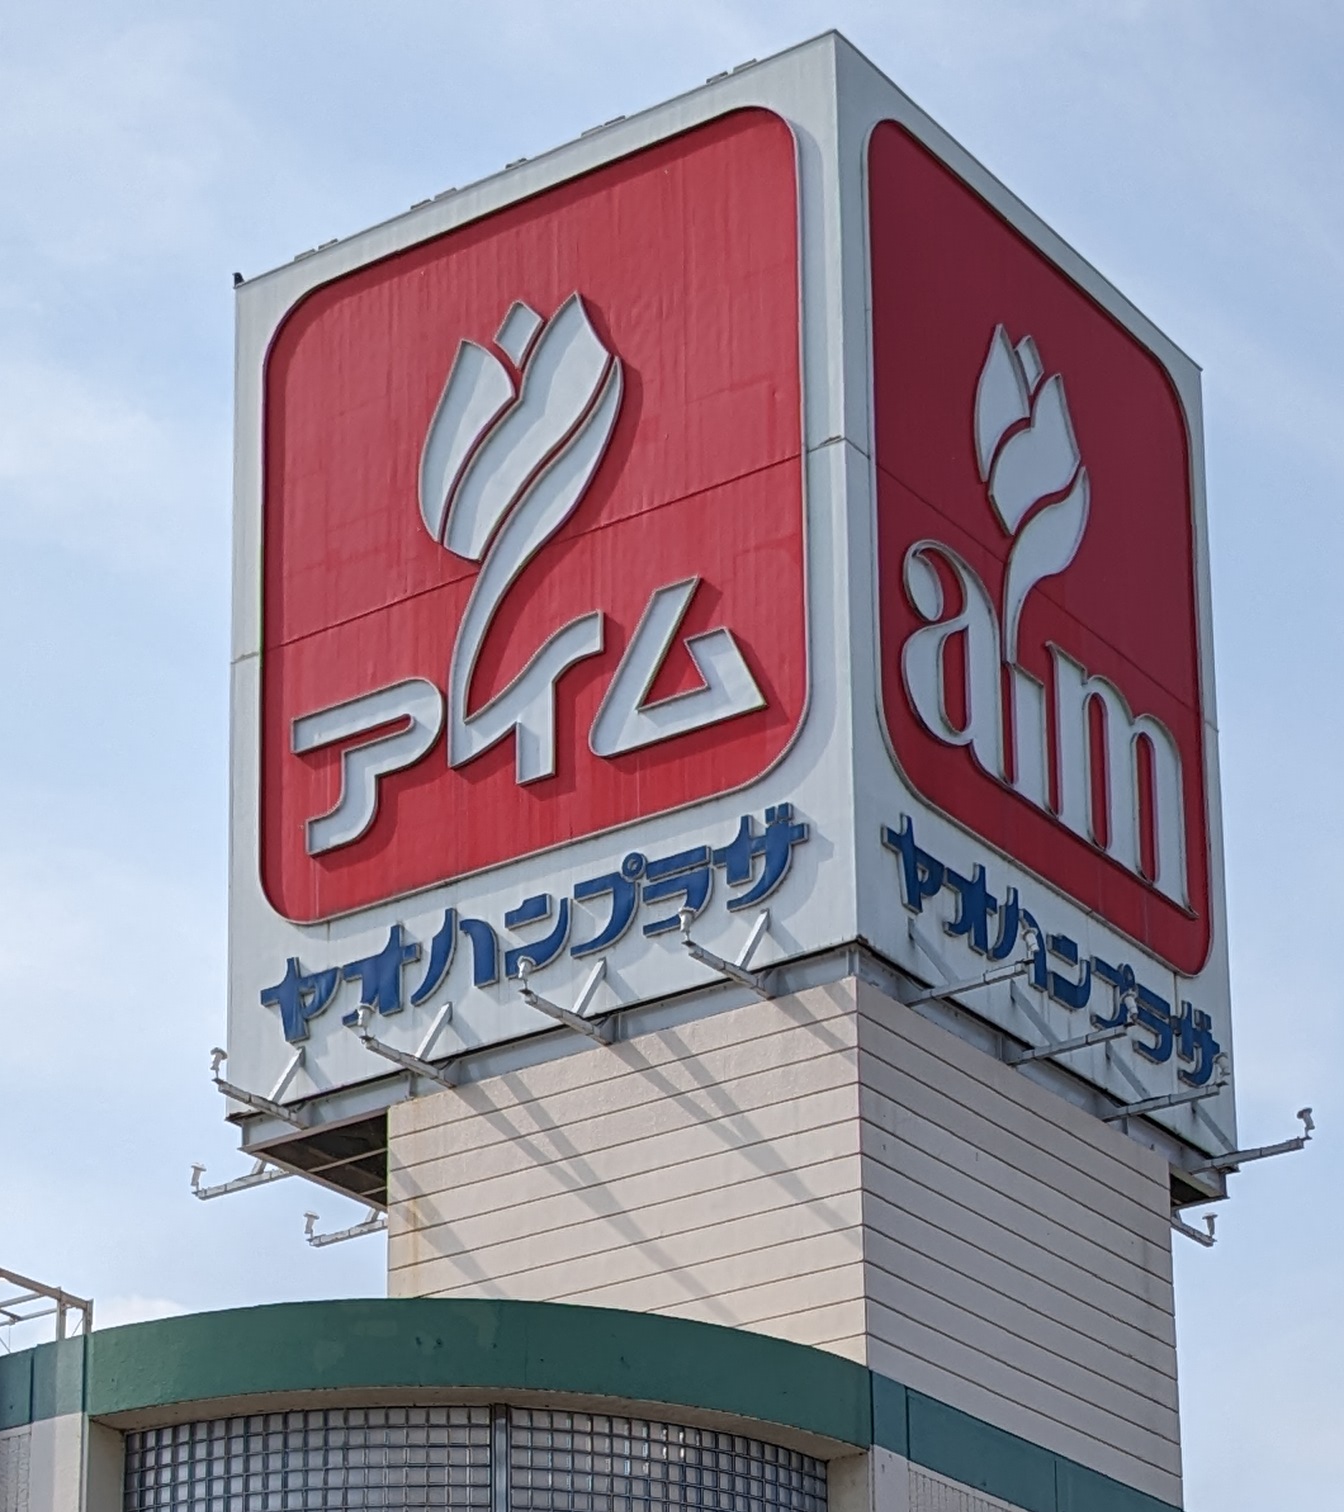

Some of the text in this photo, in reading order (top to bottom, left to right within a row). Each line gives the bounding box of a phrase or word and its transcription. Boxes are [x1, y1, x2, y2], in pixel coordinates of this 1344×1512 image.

[290, 574, 770, 857] アイム
[901, 538, 1198, 918] aim
[260, 801, 809, 1044] ヤオハンプラザ
[880, 812, 1223, 1087] ヤオハンプラザ
